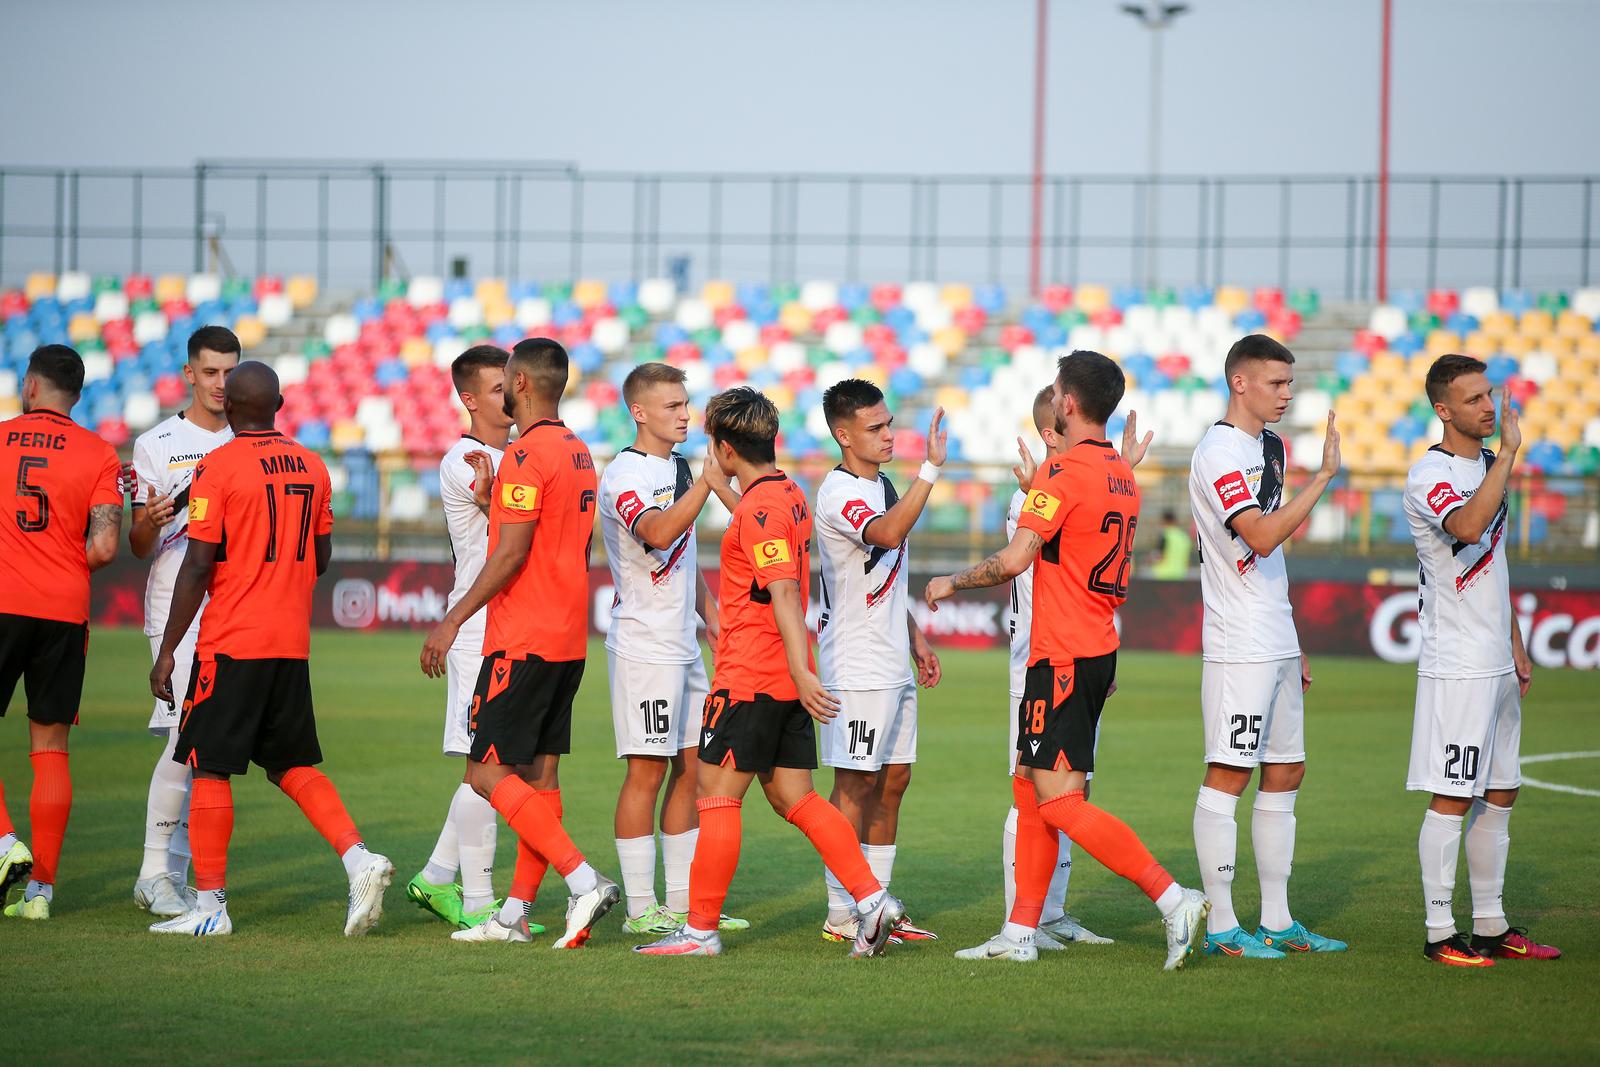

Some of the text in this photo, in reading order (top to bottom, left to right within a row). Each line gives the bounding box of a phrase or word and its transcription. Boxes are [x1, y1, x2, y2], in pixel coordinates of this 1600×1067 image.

[6, 431, 67, 451] PERIĆ
[169, 453, 208, 464] ADMIR
[260, 454, 308, 475] MINA
[16, 455, 49, 533] 5
[264, 484, 315, 562] 17
[1088, 511, 1137, 598] 28
[639, 699, 670, 735] 16
[1025, 699, 1047, 735] 28
[1229, 713, 1263, 751] 25
[848, 720, 876, 756] 14
[1444, 743, 1480, 781] 20
